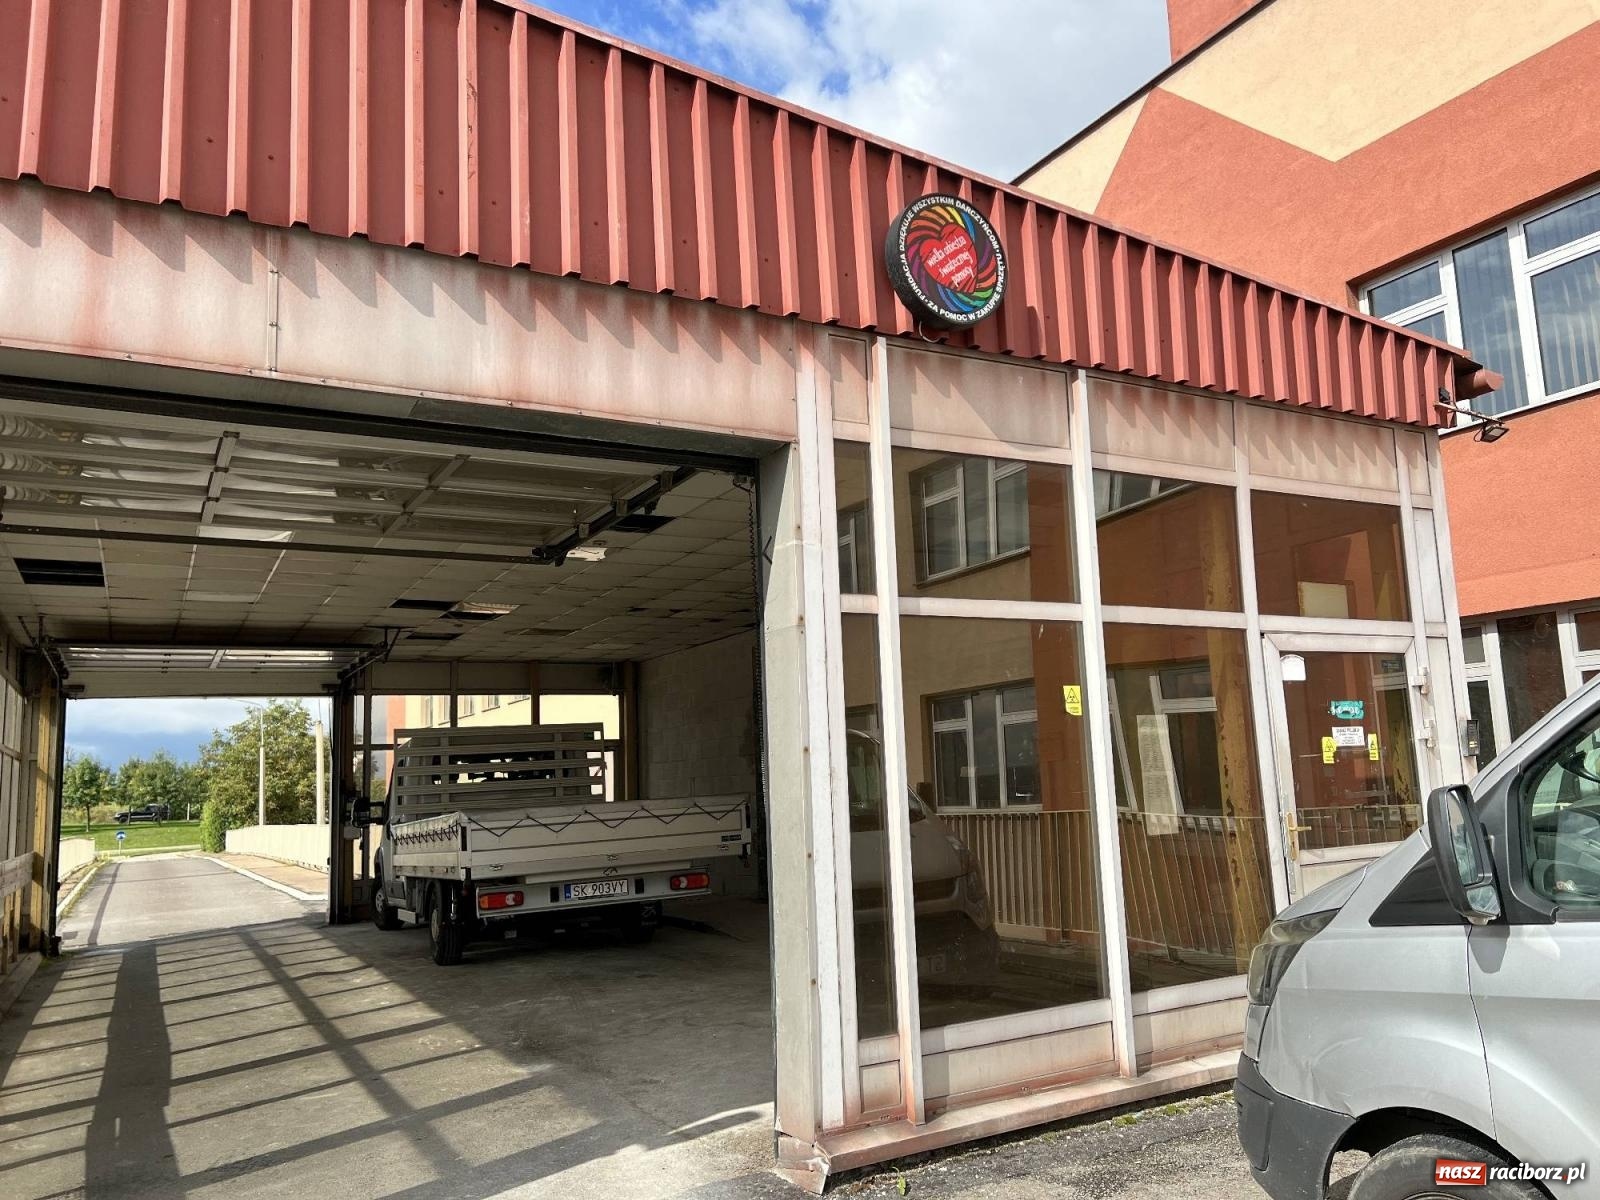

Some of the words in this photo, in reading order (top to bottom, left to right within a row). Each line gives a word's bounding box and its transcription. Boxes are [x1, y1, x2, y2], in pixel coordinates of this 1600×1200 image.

[912, 196, 954, 213] WSZYSTKIM
[899, 213, 915, 251] DZIĘKUJE
[956, 201, 999, 250] DARCZYŃCOM
[899, 253, 928, 301] FUNDACJA
[927, 301, 938, 313] ZA
[940, 310, 968, 321] POMOC
[968, 312, 976, 320] W
[977, 291, 1001, 320] ZAKUPIE
[573, 884, 588, 897] SK
[592, 881, 625, 894] 903VY
